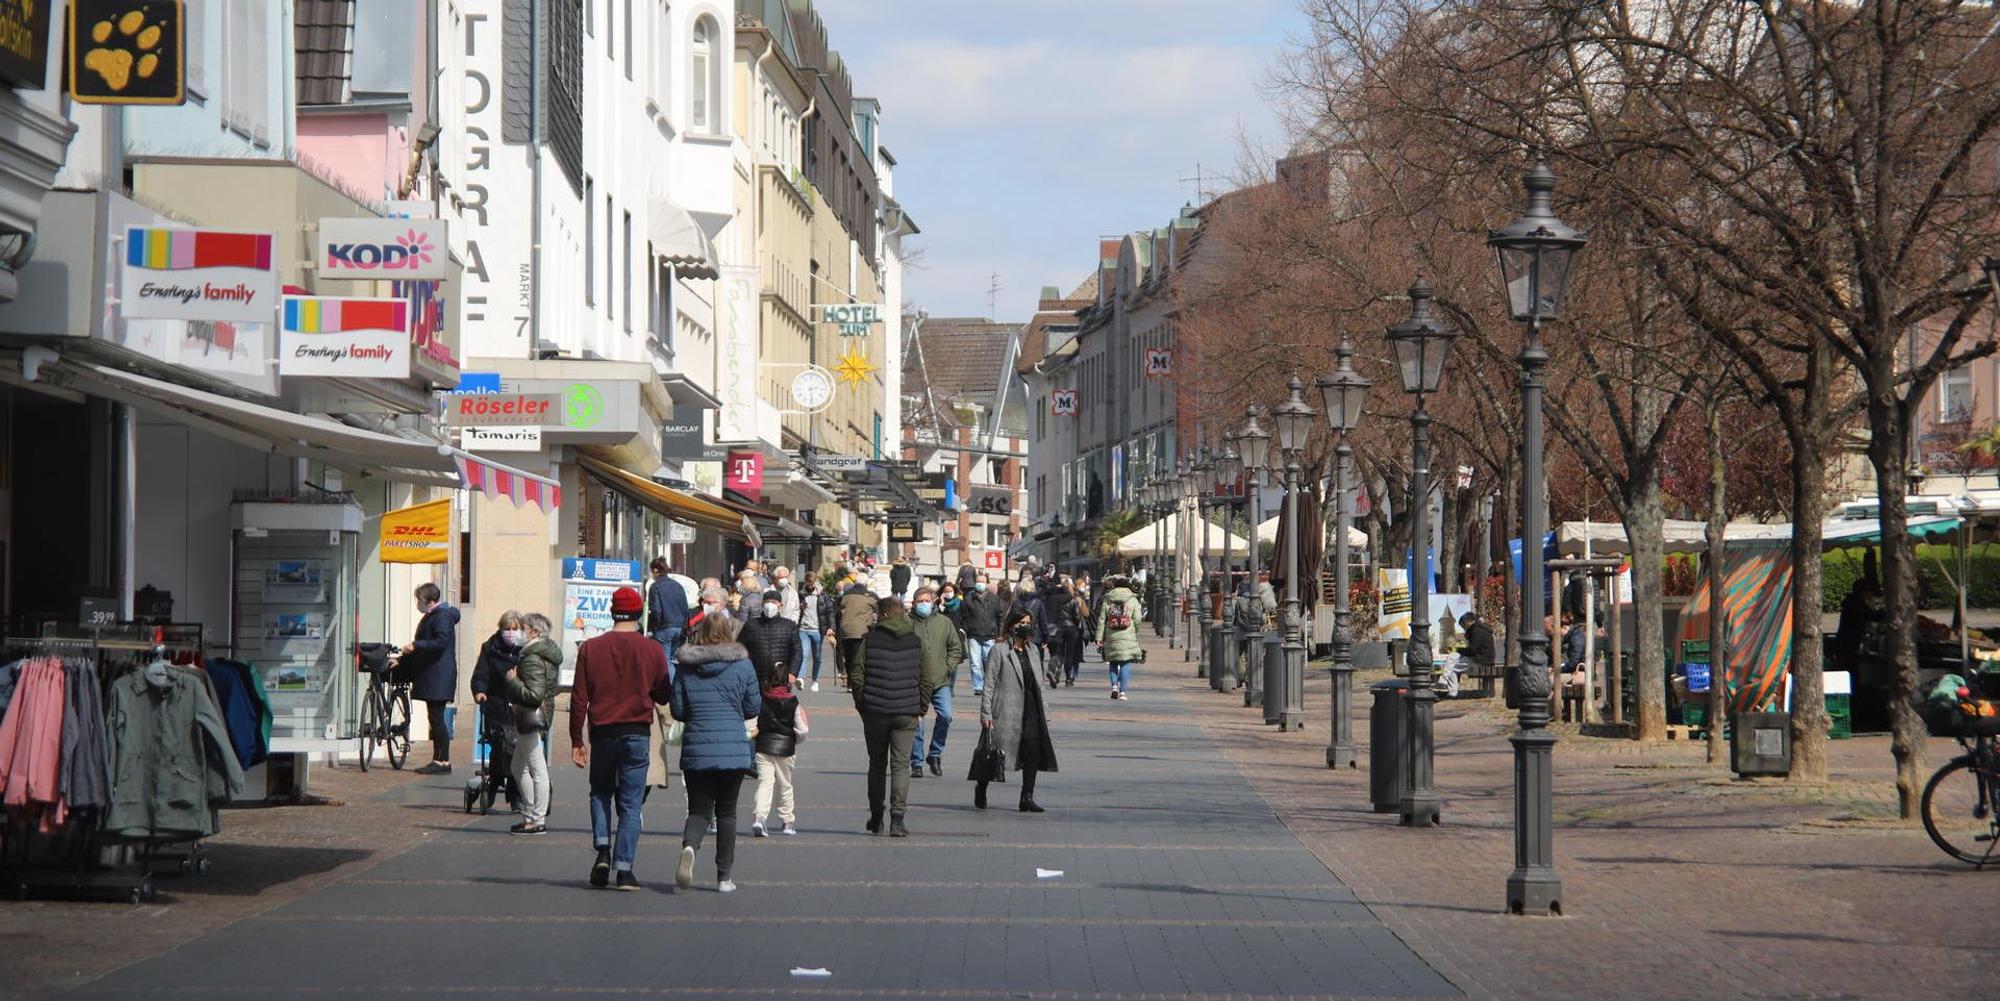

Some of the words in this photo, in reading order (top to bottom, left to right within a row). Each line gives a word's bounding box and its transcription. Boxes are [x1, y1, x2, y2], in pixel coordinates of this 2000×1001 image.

[139, 282, 202, 304] Ernsting's
[203, 282, 256, 305] family
[519, 263, 530, 310] MARKT
[823, 305, 883, 323] HOTEL
[513, 316, 530, 338] 7
[839, 323, 871, 337] ZUM
[295, 344, 348, 362] Ernsting's
[349, 343, 393, 362] family
[1152, 356, 1168, 369] M
[460, 395, 549, 415] Röseler
[1058, 397, 1072, 409] M
[665, 425, 699, 433] BARCLAY
[393, 526, 437, 536] DHL
[384, 540, 431, 549] PAKETSHOP
[577, 588, 593, 596] EINE
[596, 588, 613, 596] ZAH
[576, 596, 609, 611] ZW
